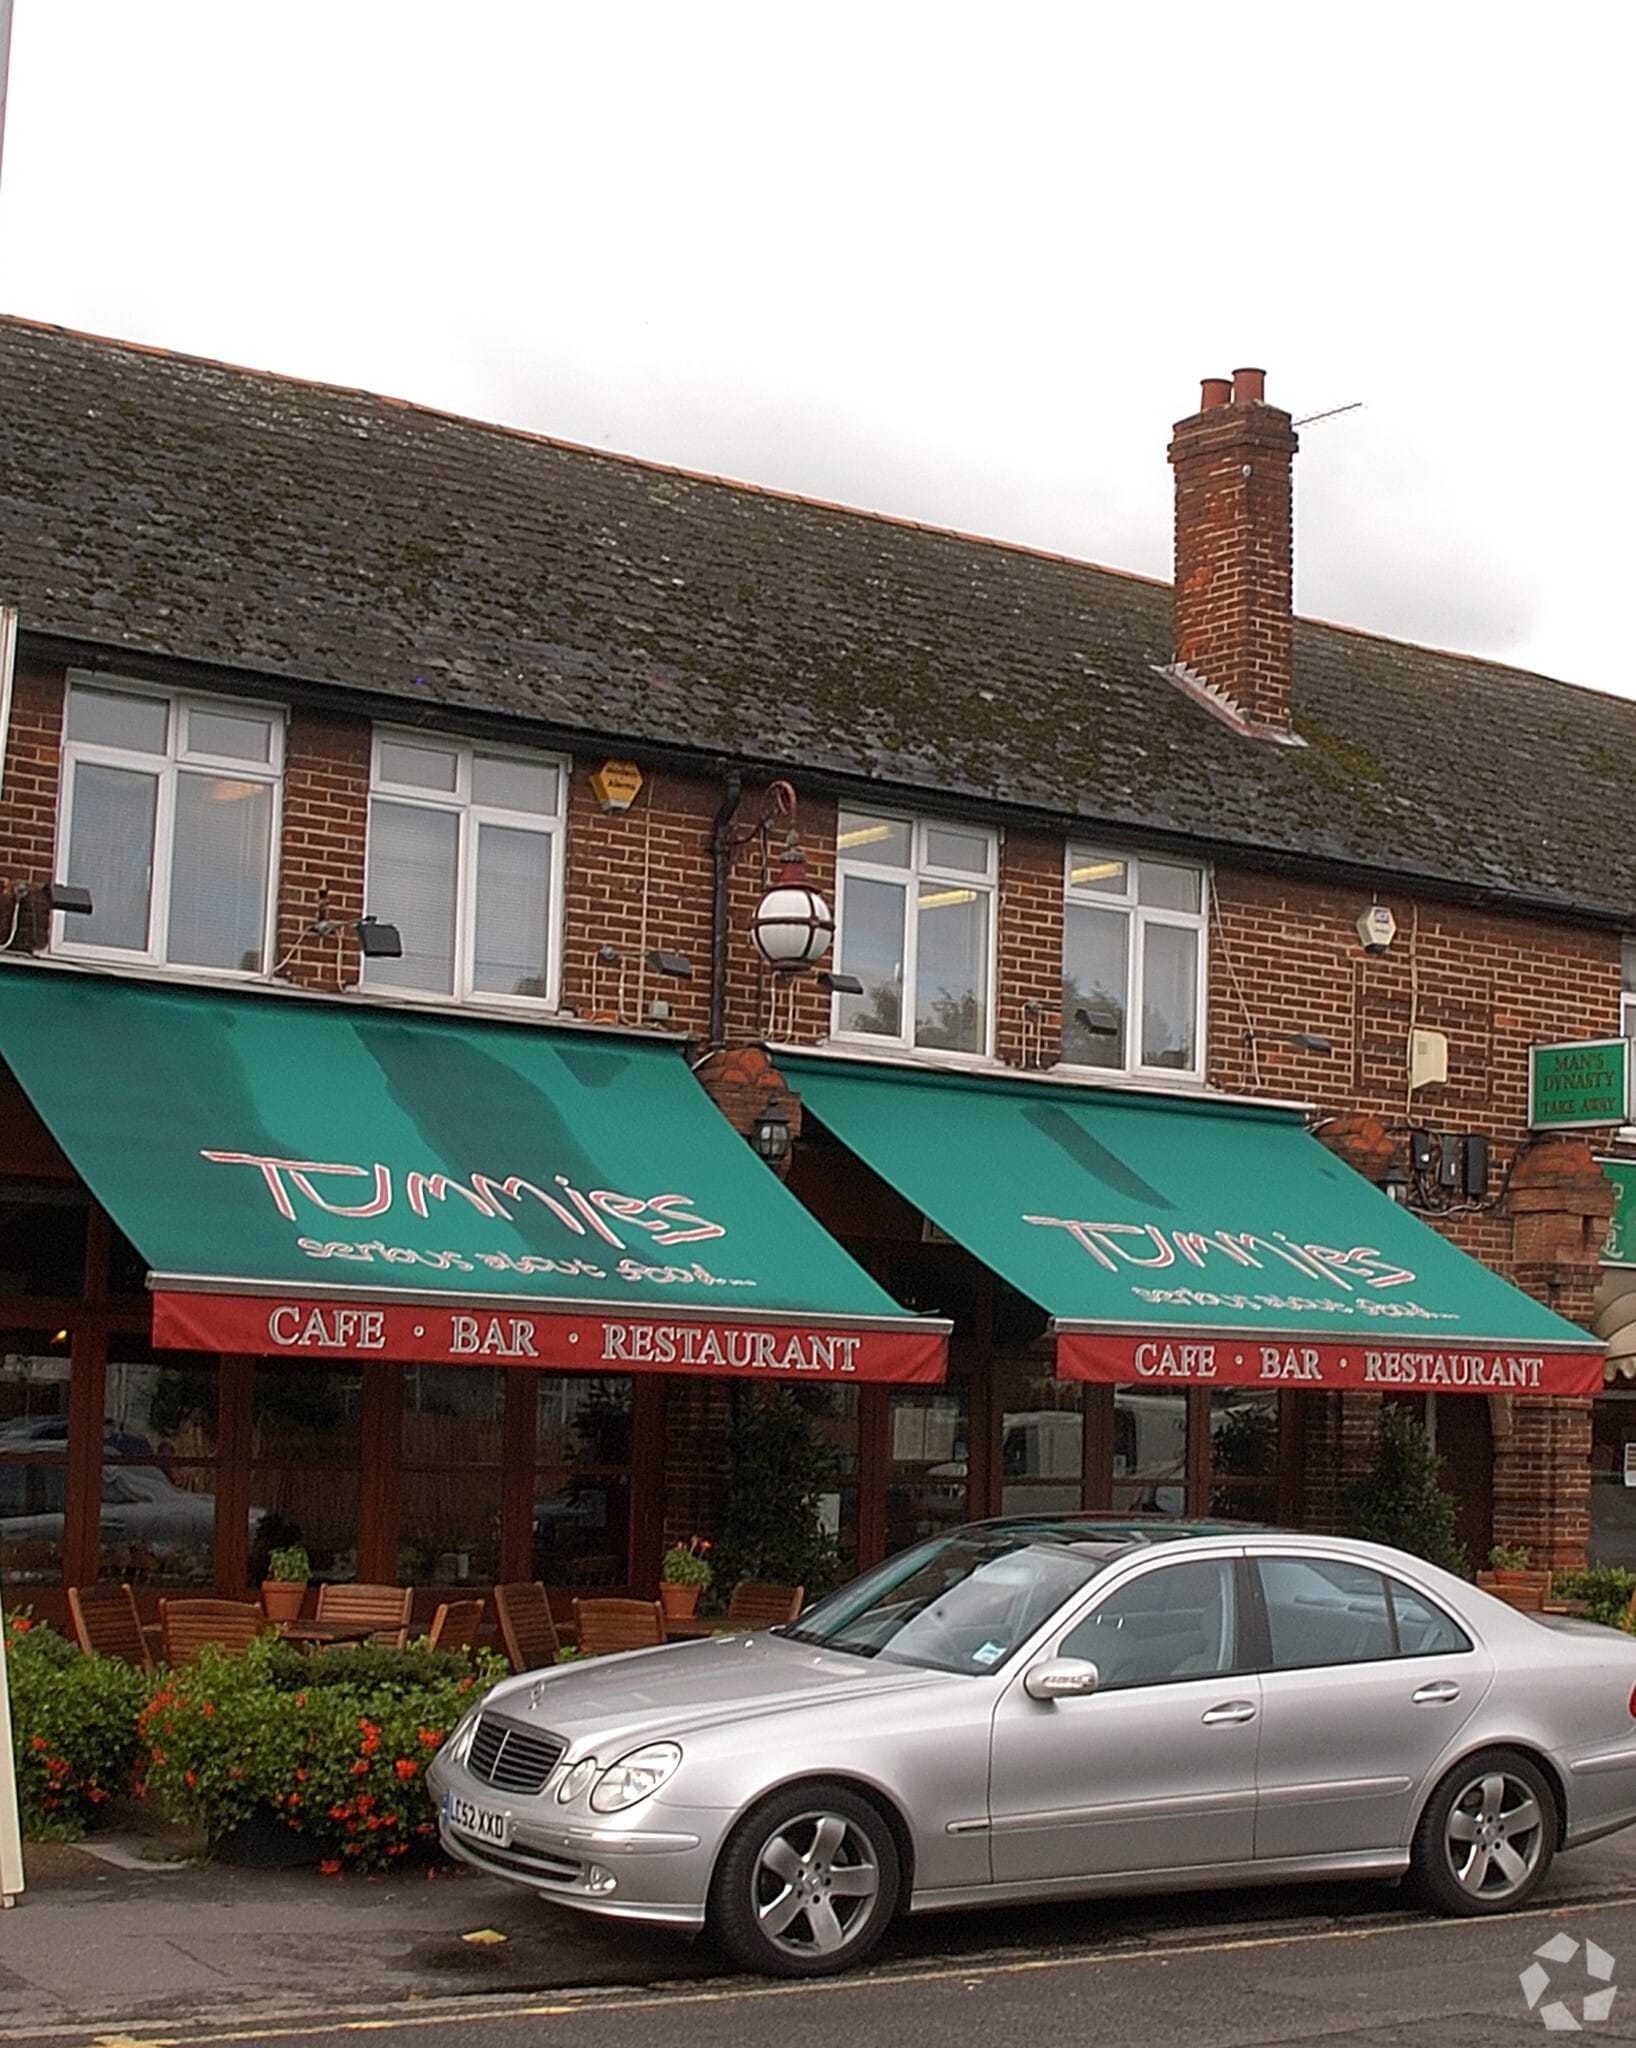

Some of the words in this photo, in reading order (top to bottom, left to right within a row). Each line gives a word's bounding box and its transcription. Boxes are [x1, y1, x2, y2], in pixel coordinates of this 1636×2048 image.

[1543, 1071, 1615, 1092] DYNASTY
[1542, 1100, 1576, 1116] TAKE
[1581, 1096, 1616, 1113] AWAY
[297, 1237, 474, 1272] serious
[475, 1251, 606, 1279] about
[269, 1307, 386, 1349] CAFE
[450, 1316, 539, 1357] BAR
[601, 1324, 860, 1371] RESTAURANT
[1135, 1344, 1217, 1377] CAFE
[1259, 1347, 1322, 1380] BAR
[1364, 1351, 1544, 1387] RESTAURANT
